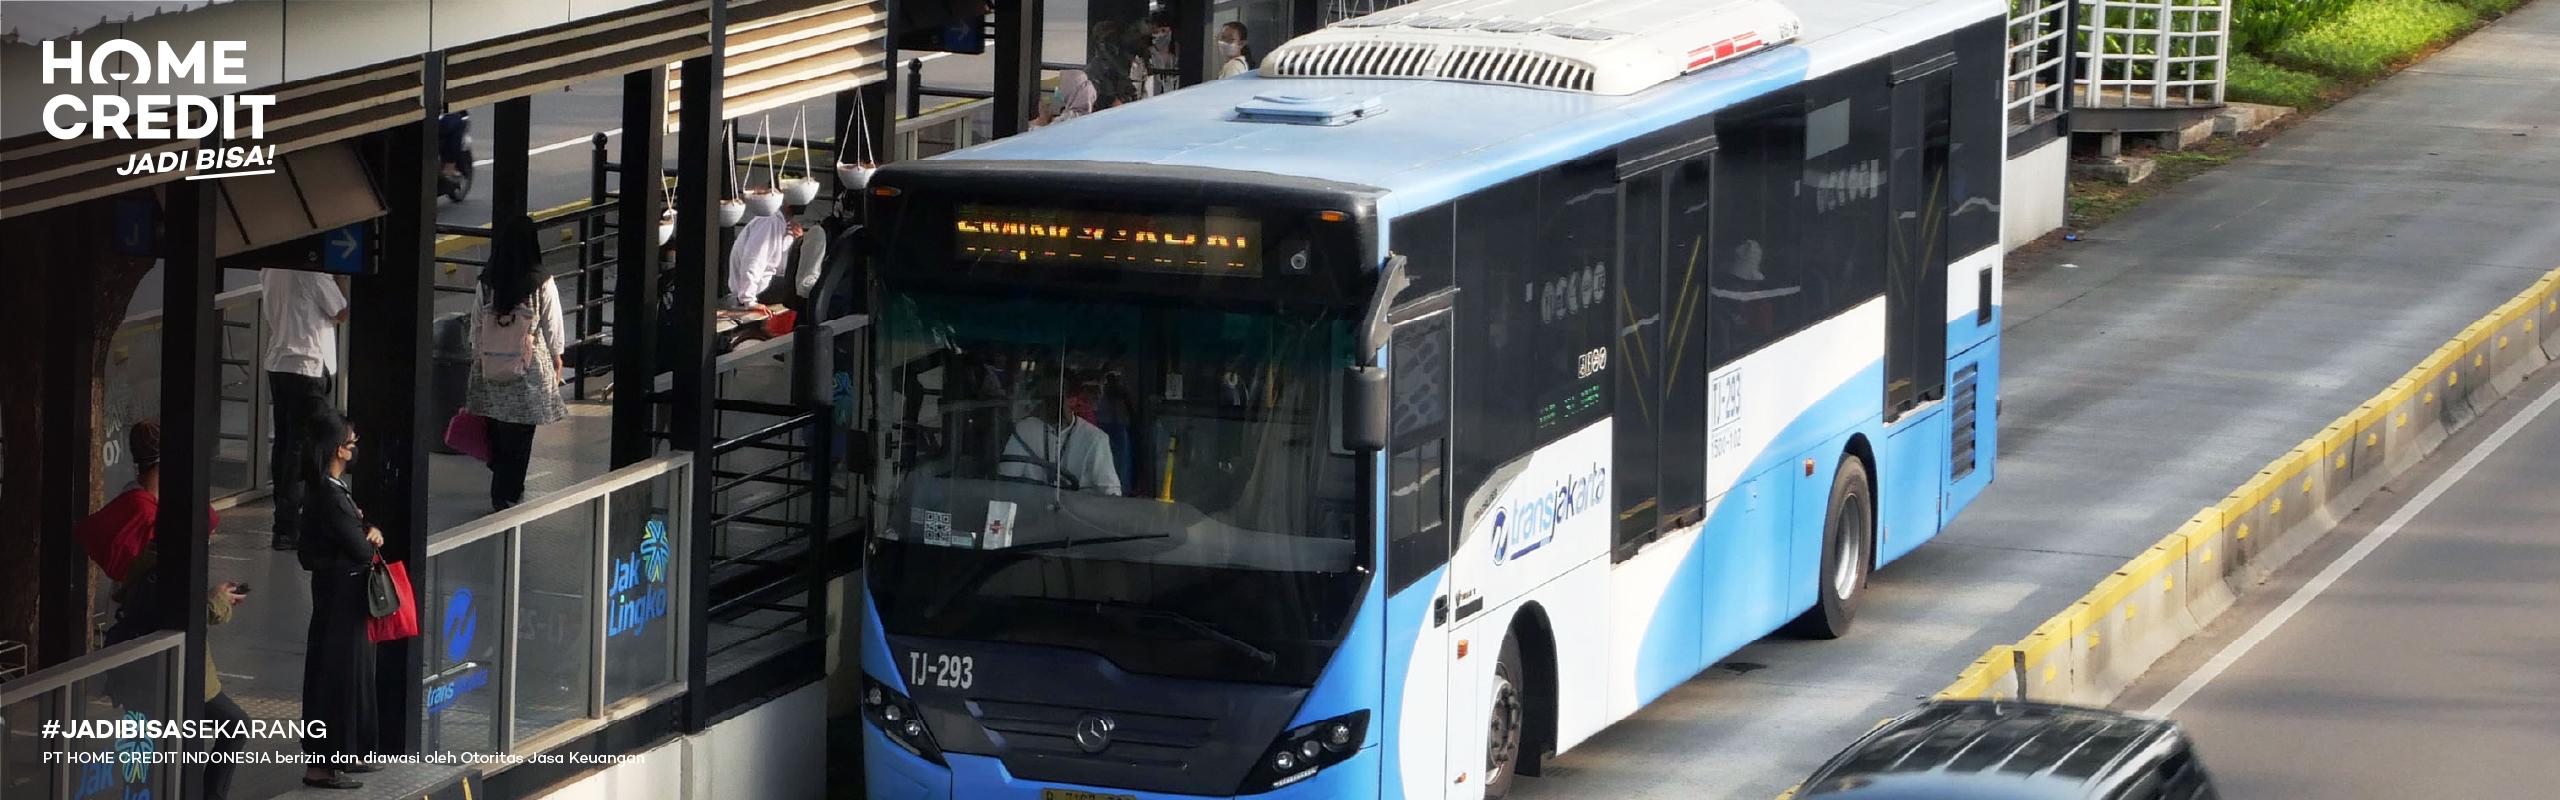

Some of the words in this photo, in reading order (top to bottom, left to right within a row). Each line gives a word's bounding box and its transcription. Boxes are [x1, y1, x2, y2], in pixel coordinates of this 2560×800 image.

[1712, 372, 1741, 425] TJ-293
[1510, 461, 1606, 552] transjakarta
[608, 551, 641, 597] Jak
[607, 582, 668, 637] Lingko
[909, 651, 973, 690] TJ-293
